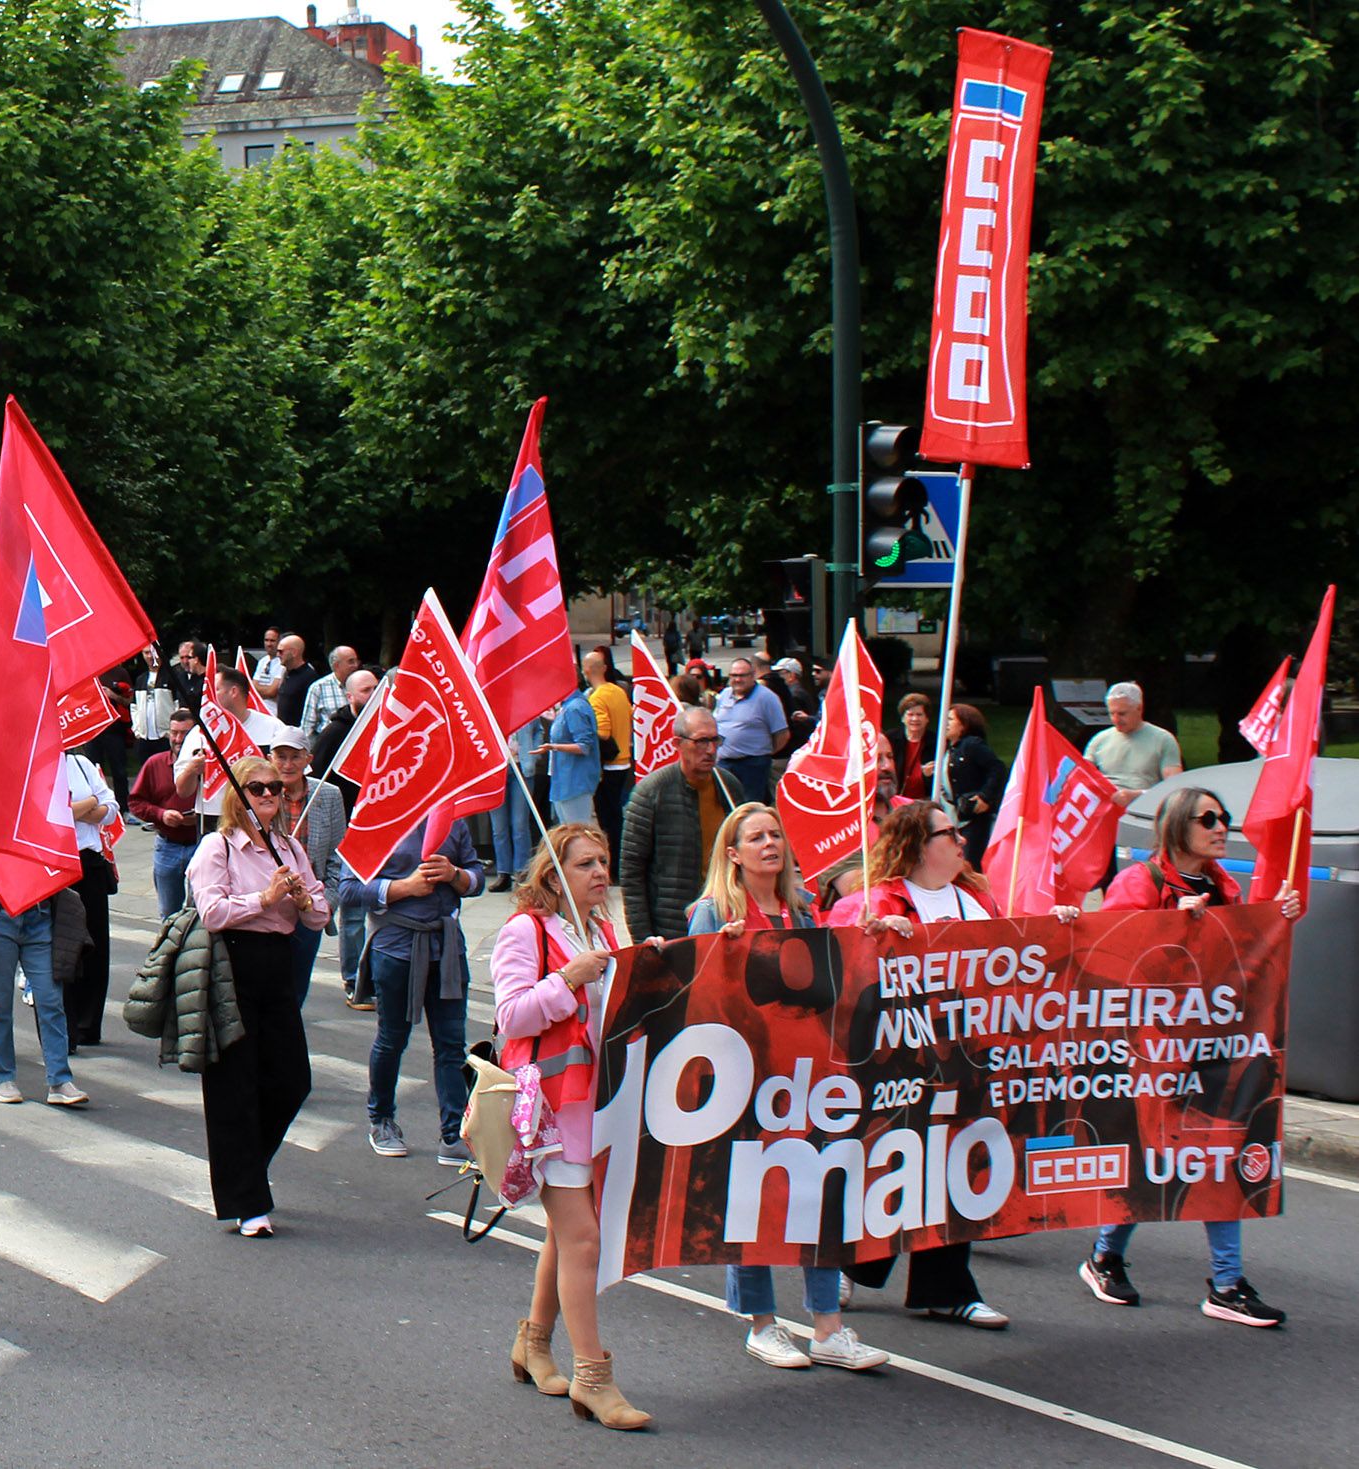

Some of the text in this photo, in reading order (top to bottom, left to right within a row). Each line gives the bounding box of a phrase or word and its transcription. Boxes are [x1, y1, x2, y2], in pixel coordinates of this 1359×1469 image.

[947, 139, 1004, 404] CCOO
[59, 704, 91, 730] gt.es
[875, 984, 1244, 1051] NON TRINCHEIRAS.
[988, 1032, 1272, 1073] SALARIOS, VIVENDA
[754, 1057, 862, 1134] de
[871, 1077, 925, 1112] 2026
[990, 1071, 1204, 1108] E DEMOCRACIA
[723, 1090, 1016, 1245] maio
[1032, 1154, 1121, 1186] CCOO
[1144, 1145, 1236, 1184] UGT
